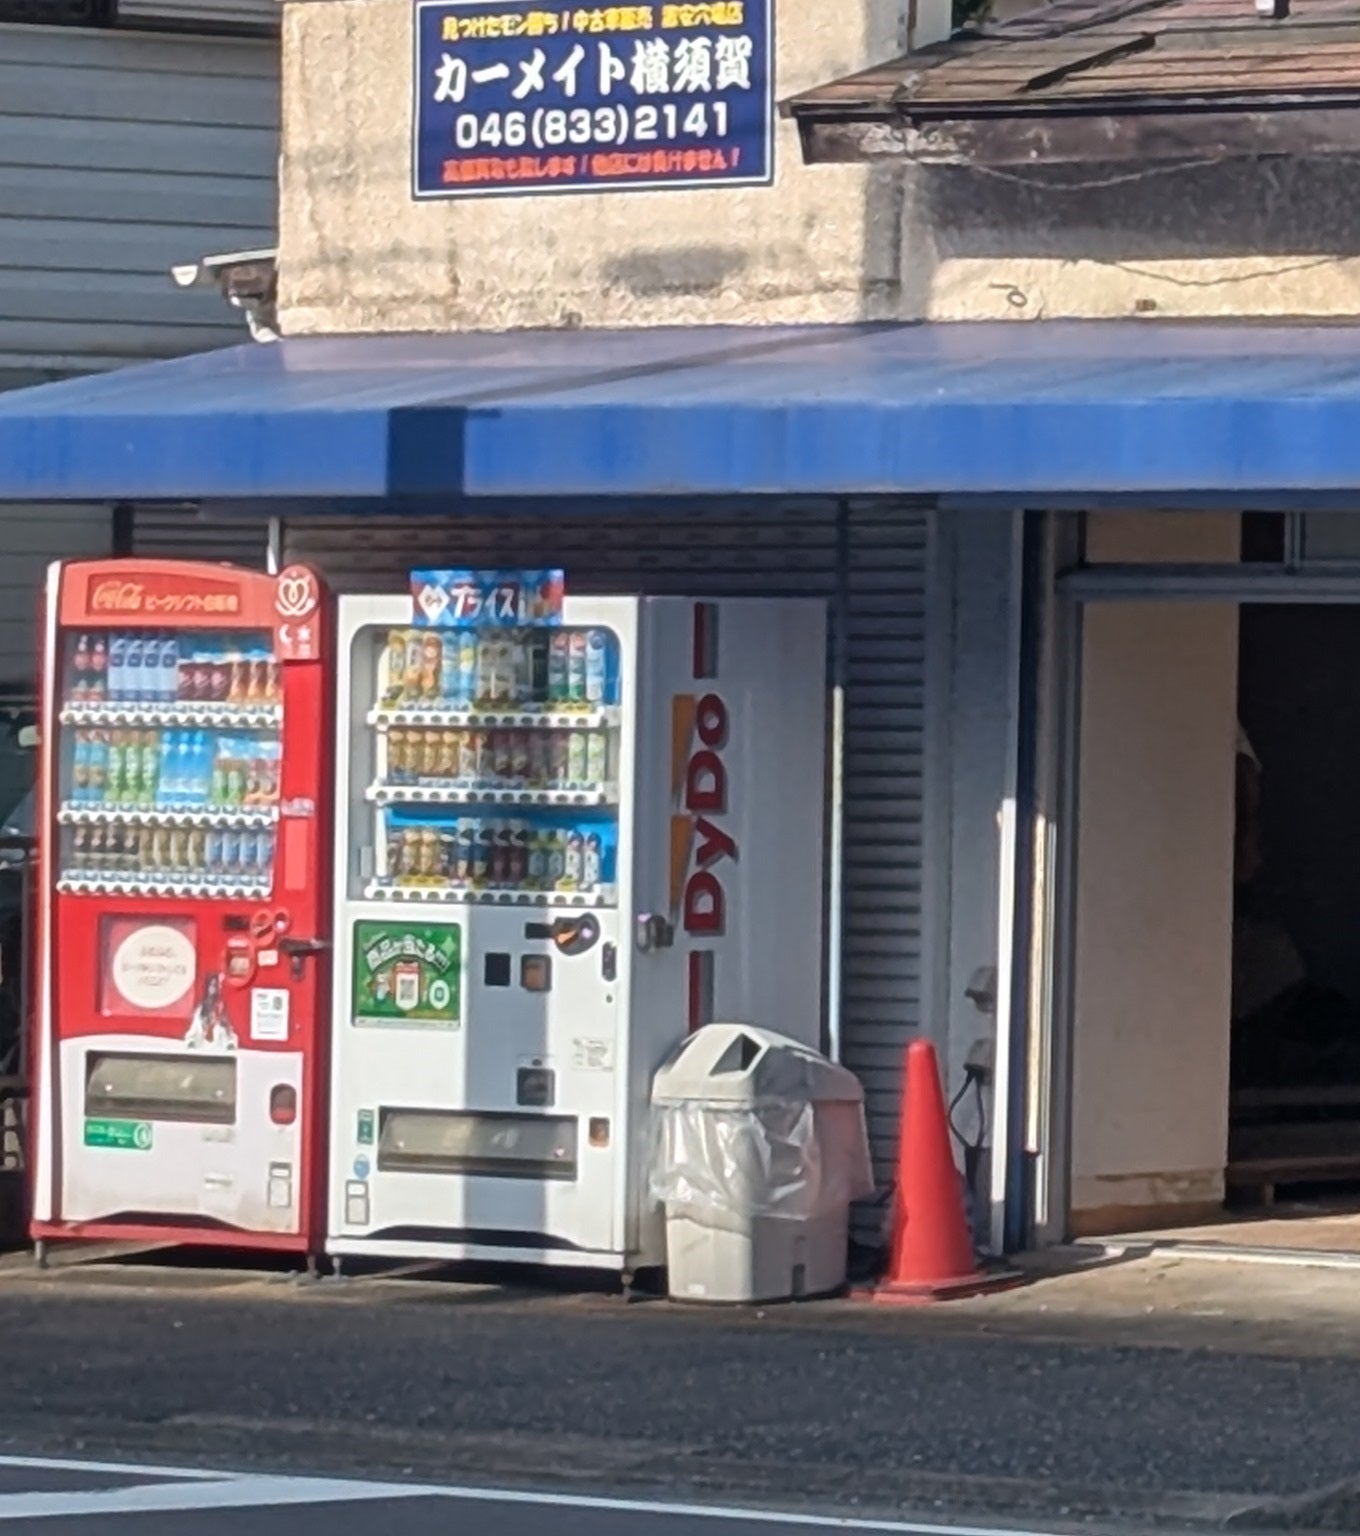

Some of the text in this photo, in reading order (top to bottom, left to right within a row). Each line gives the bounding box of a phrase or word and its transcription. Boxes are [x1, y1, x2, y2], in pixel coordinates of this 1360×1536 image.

[433, 34, 754, 103] カーメイト横須賀
[455, 101, 728, 150] 046(833)2141
[684, 693, 738, 934] DyDo
